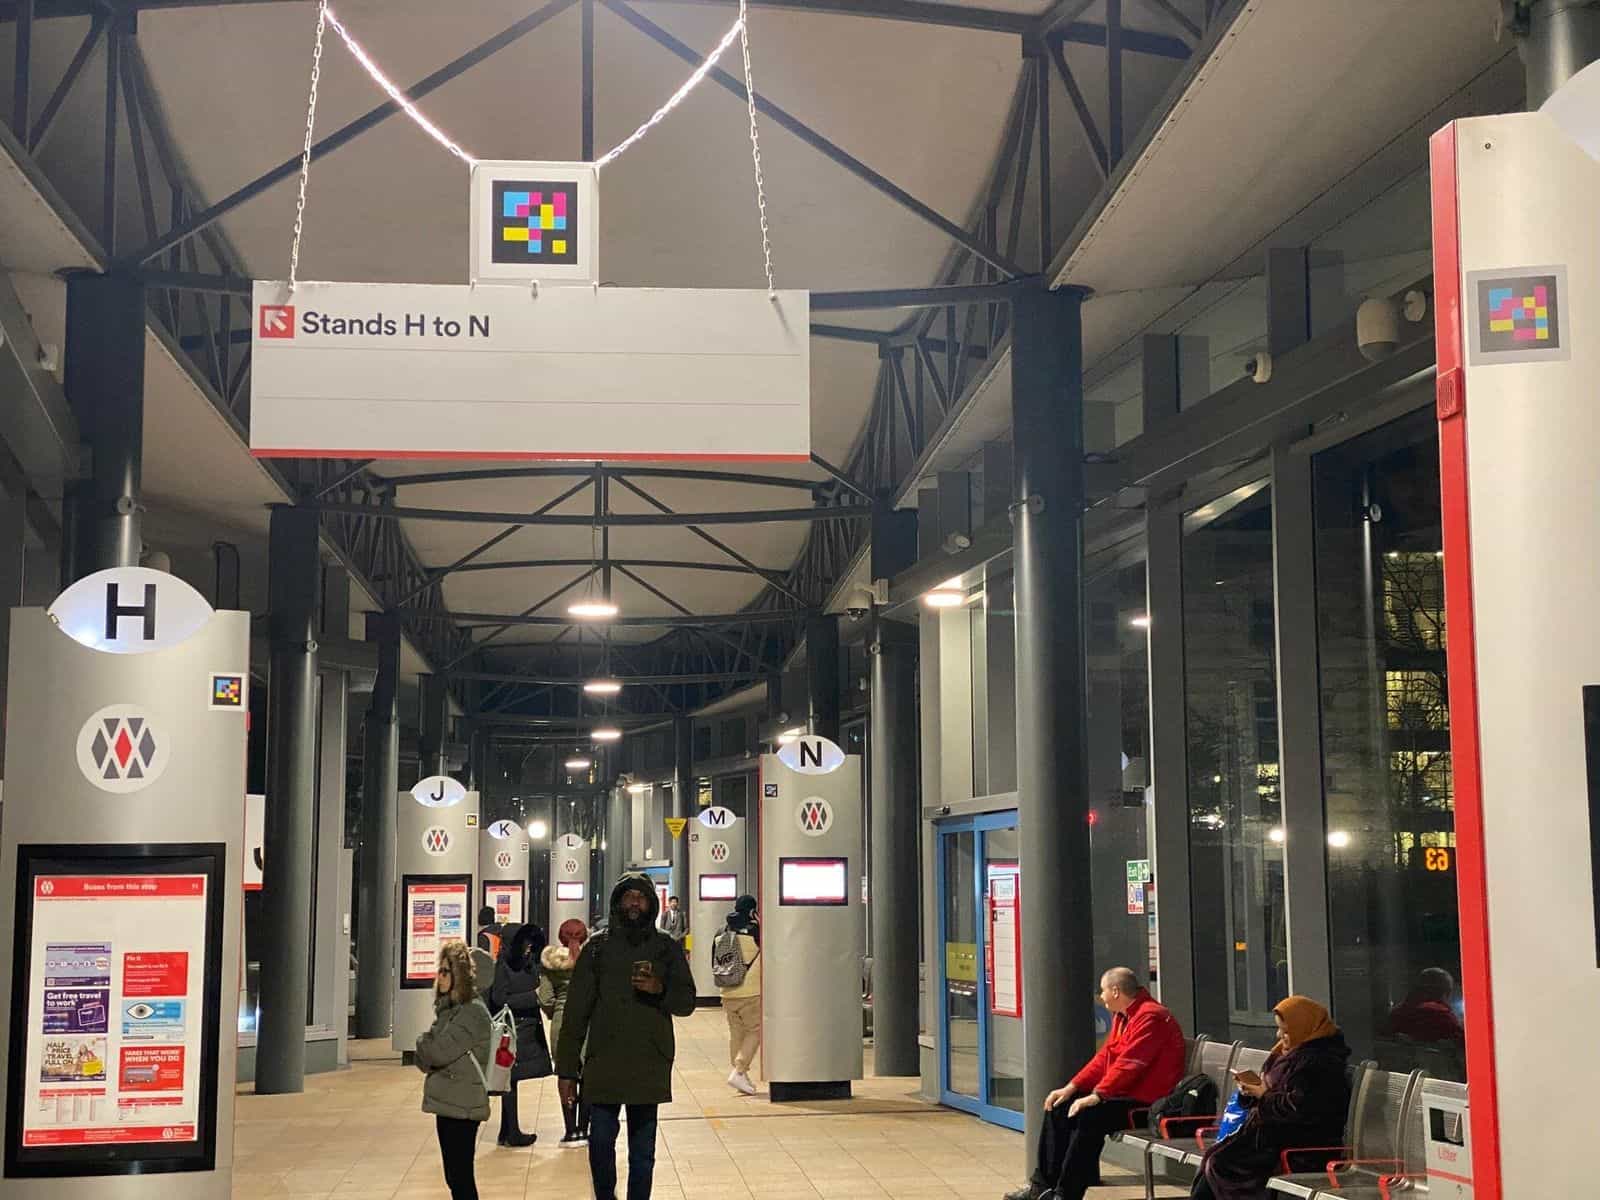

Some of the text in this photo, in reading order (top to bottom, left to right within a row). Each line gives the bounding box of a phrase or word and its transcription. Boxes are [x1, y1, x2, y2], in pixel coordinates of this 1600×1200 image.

[302, 312, 490, 338] Stands H to N
[106, 583, 156, 640] H
[800, 741, 822, 767] N
[430, 781, 444, 802] J
[708, 810, 726, 825] M
[499, 823, 510, 836] K
[566, 835, 574, 847] L
[47, 992, 62, 1000] Get
